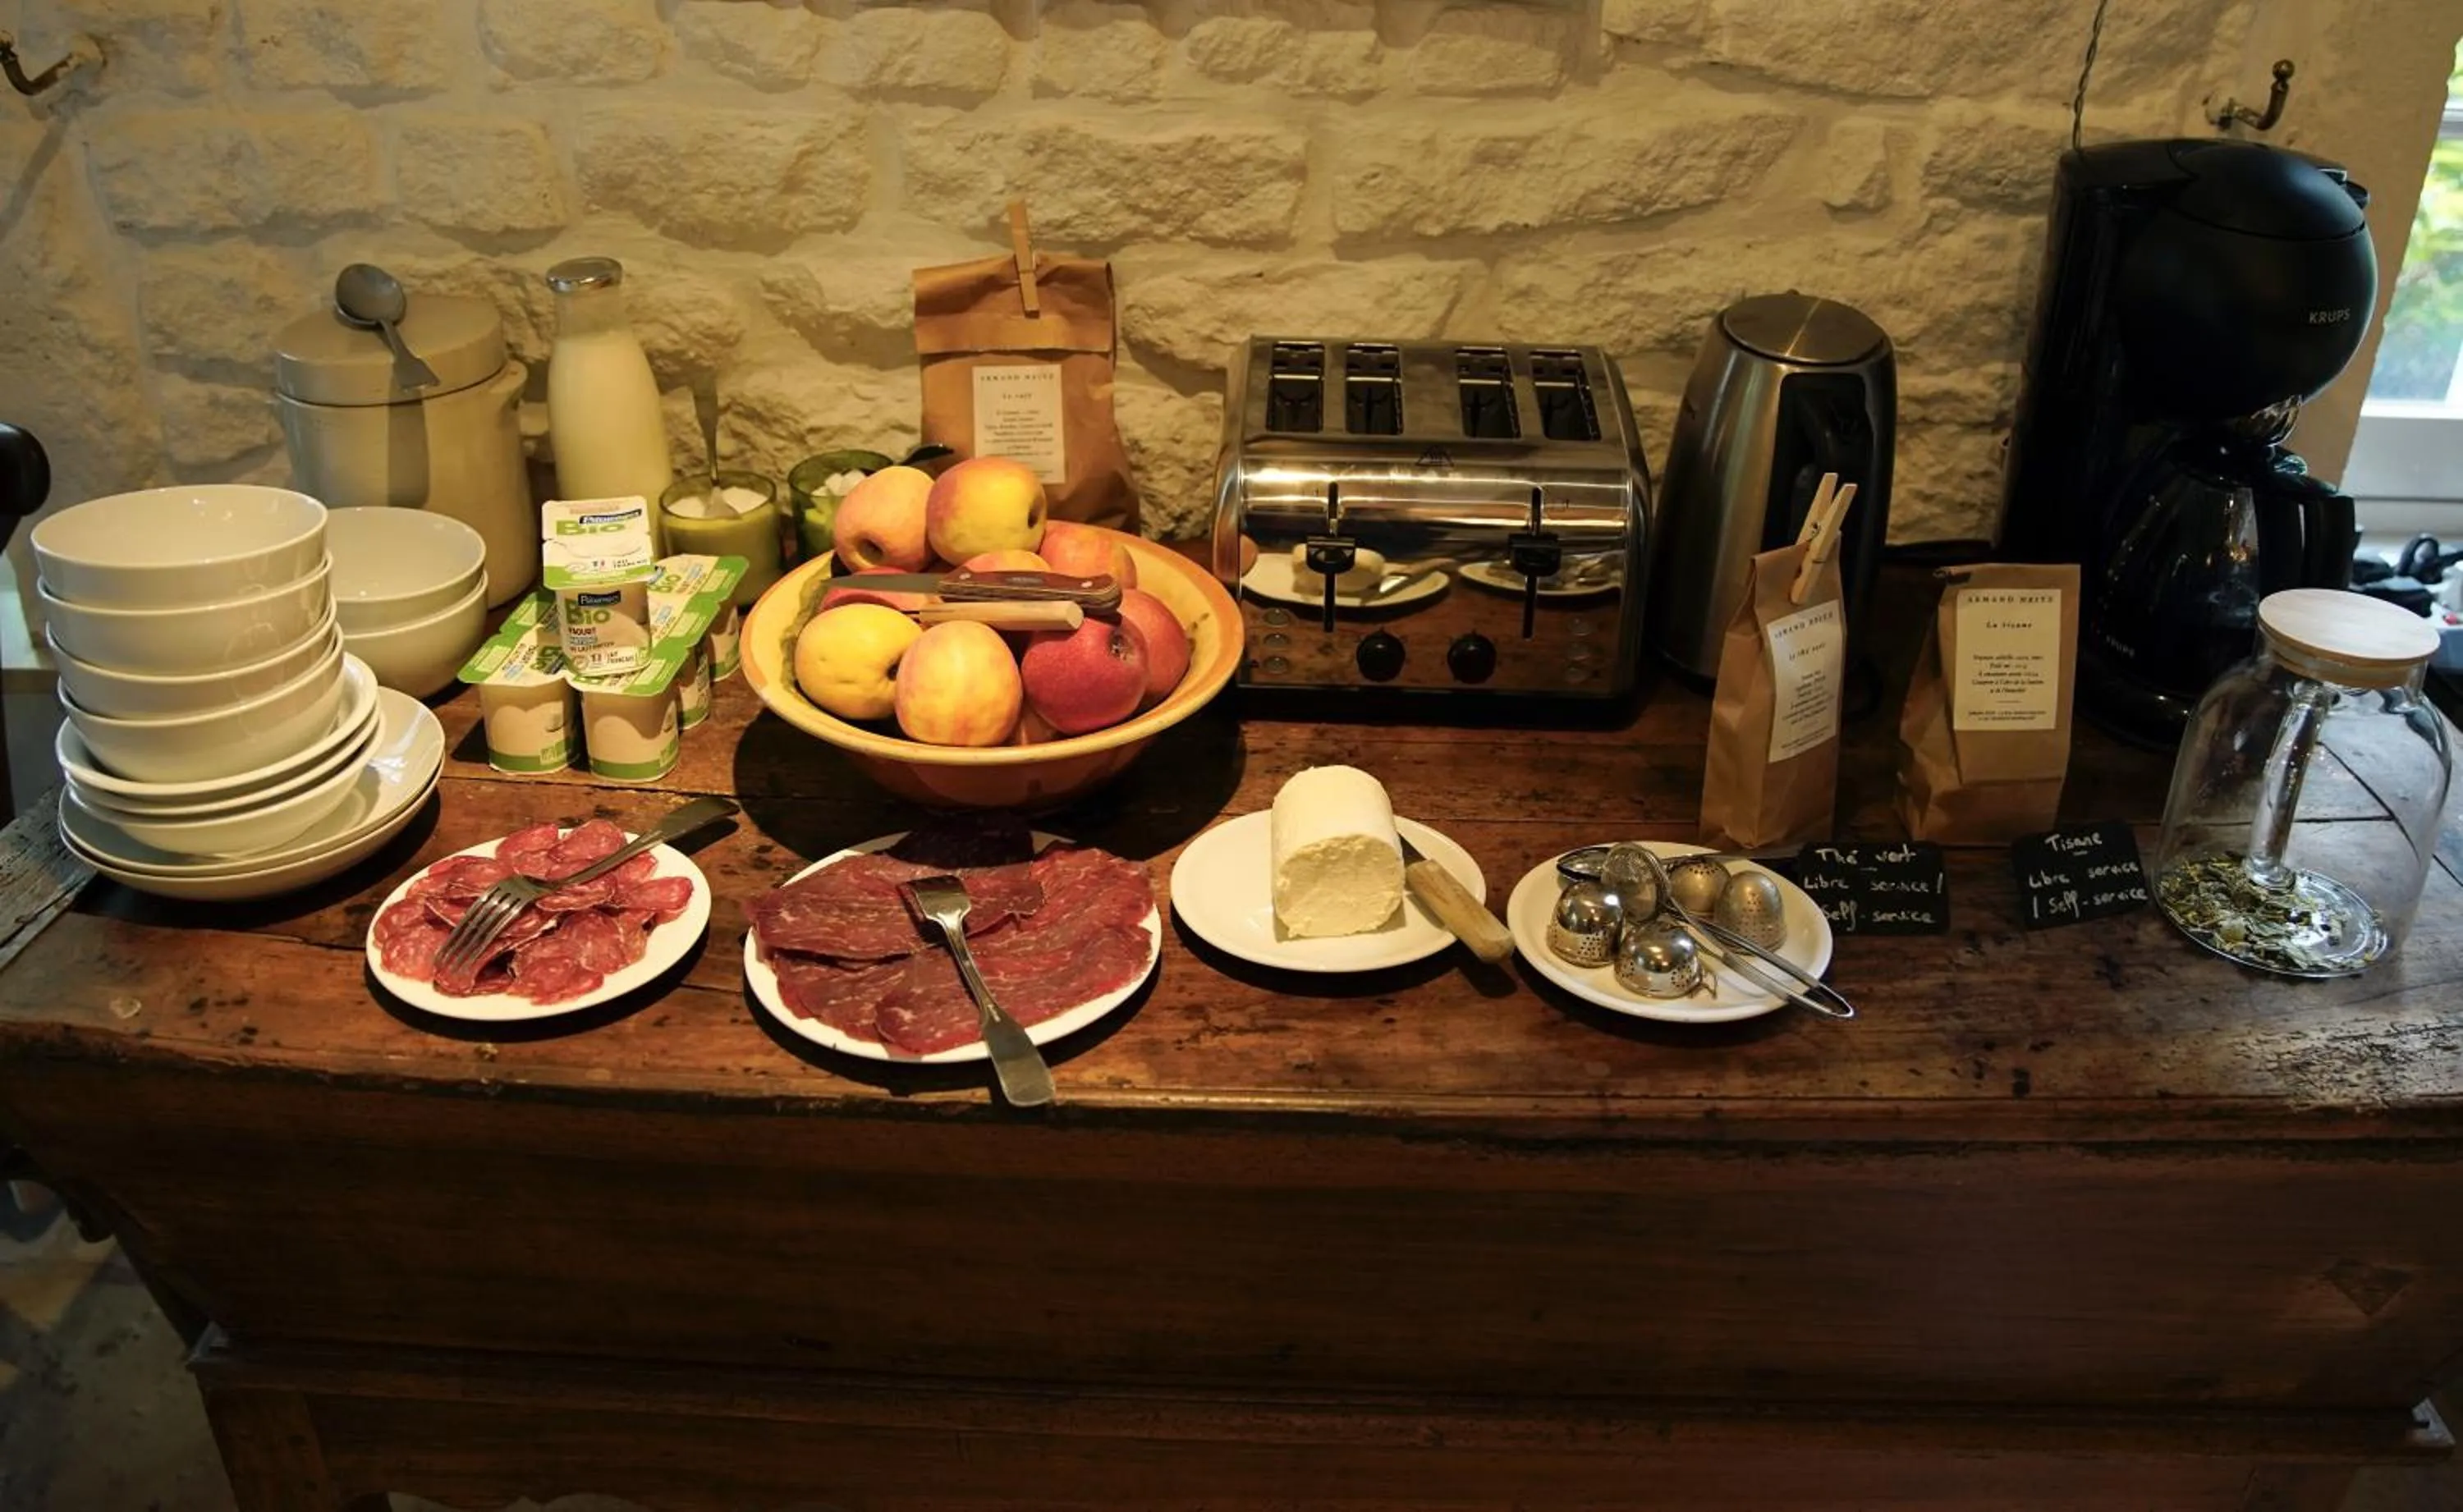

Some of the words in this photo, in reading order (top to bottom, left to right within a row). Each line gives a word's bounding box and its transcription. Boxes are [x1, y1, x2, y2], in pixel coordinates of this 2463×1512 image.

[2309, 308, 2351, 324] KRUPS
[2044, 832, 2103, 852] Tisane
[1814, 848, 1860, 865] Thé
[1874, 843, 1917, 863] vert
[1803, 873, 1850, 890] Libre
